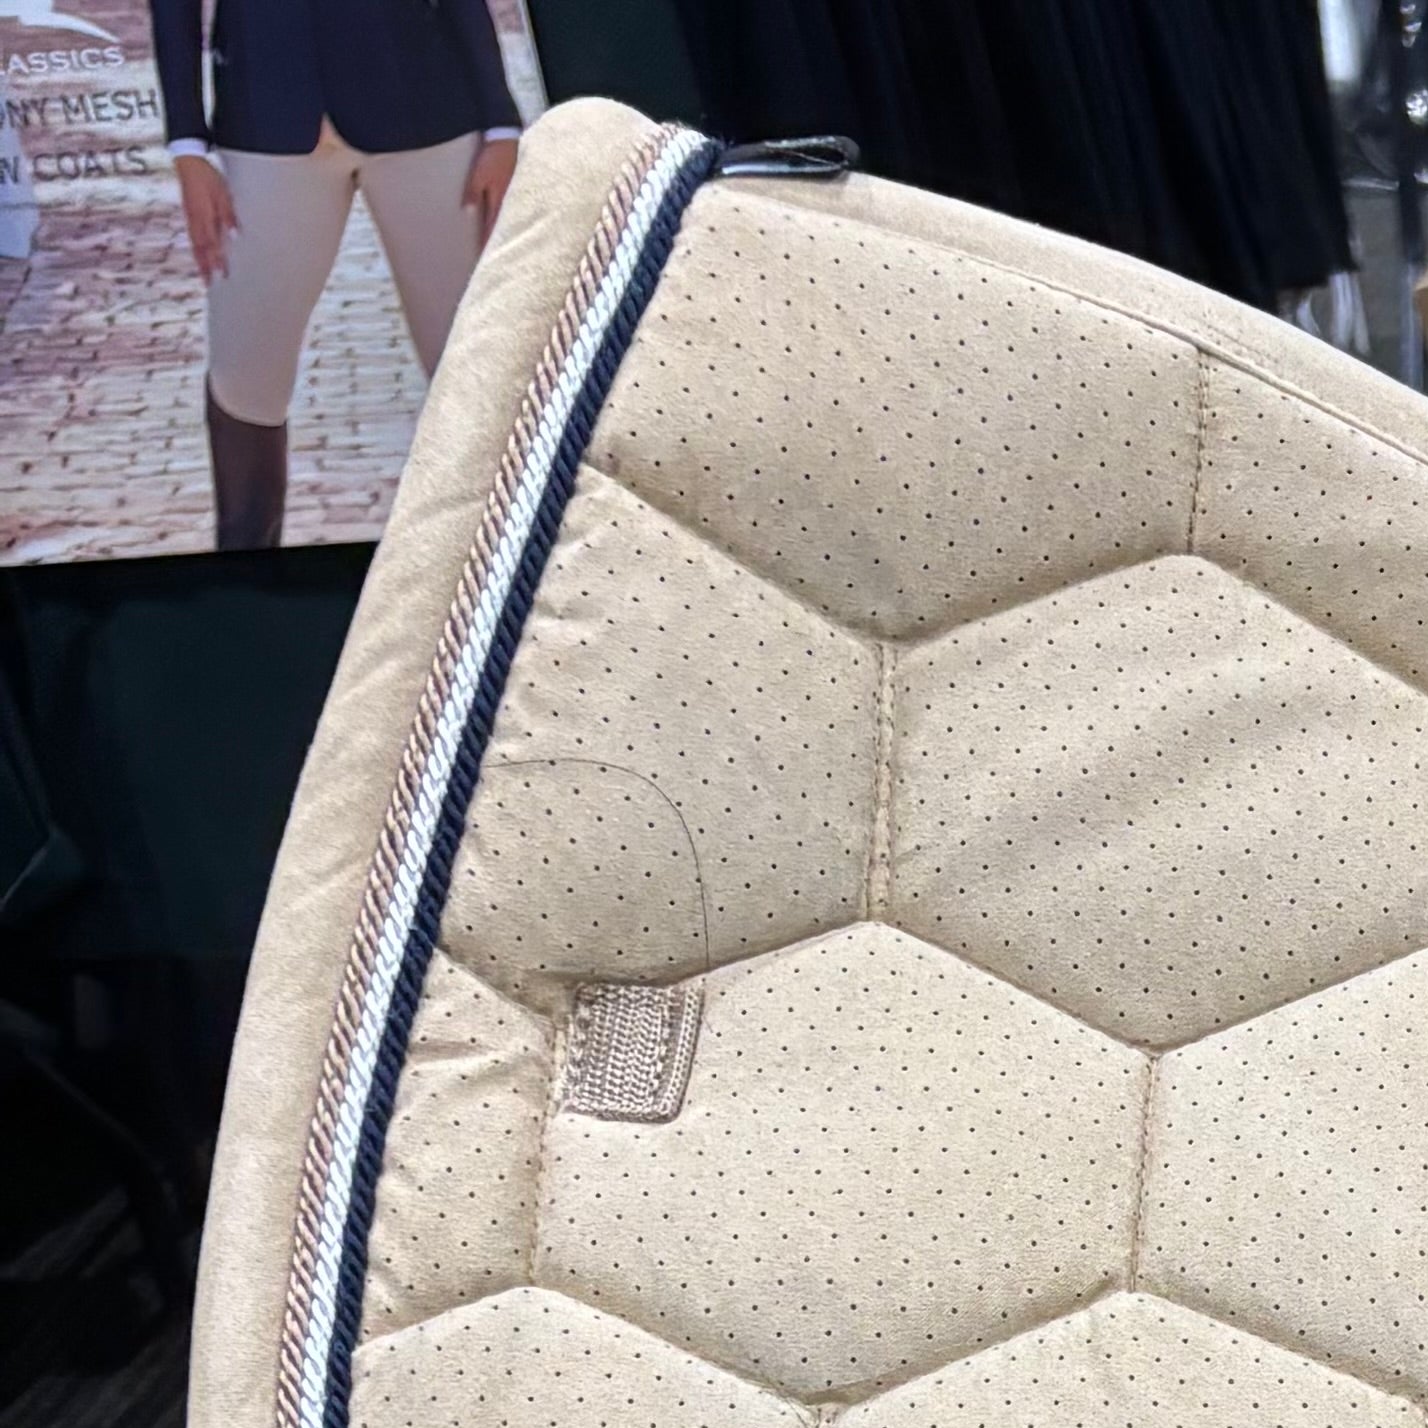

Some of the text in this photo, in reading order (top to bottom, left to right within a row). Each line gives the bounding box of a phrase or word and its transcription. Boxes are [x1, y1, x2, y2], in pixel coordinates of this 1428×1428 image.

[0, 89, 159, 130] NY MESH
[32, 146, 148, 182] COATS
